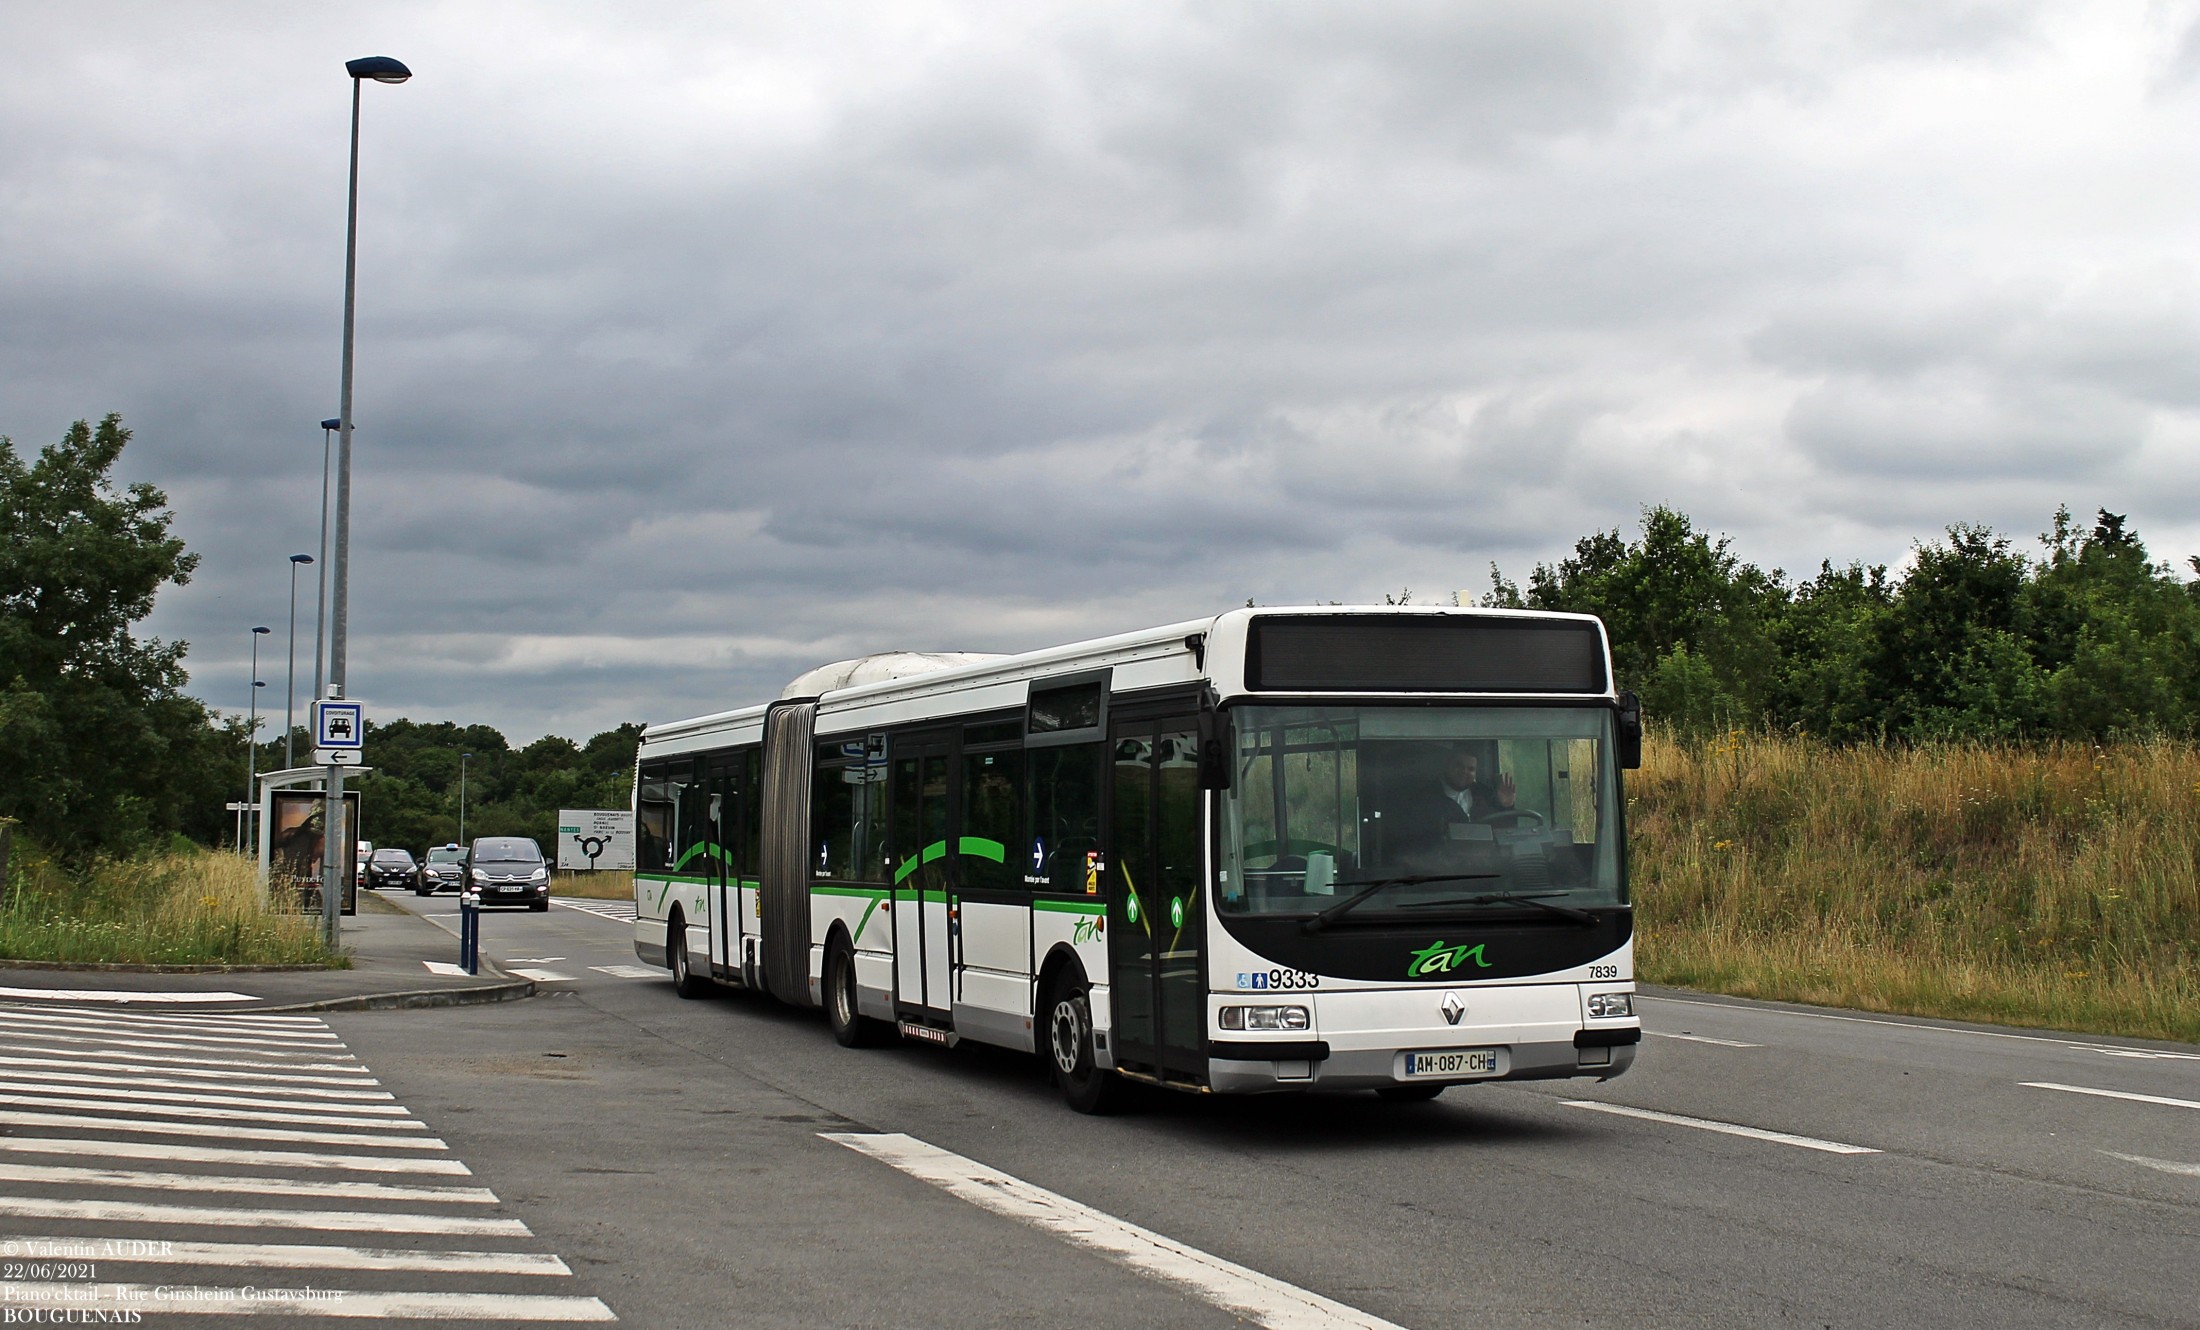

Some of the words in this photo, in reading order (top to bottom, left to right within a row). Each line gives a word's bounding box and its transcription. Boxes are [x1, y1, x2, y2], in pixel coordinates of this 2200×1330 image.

[1073, 915, 1101, 945] tan
[1407, 940, 1493, 977] tan
[1269, 969, 1320, 989] 9333
[1588, 965, 1617, 978] 7839
[1416, 1054, 1486, 1072] AM-087-CH
